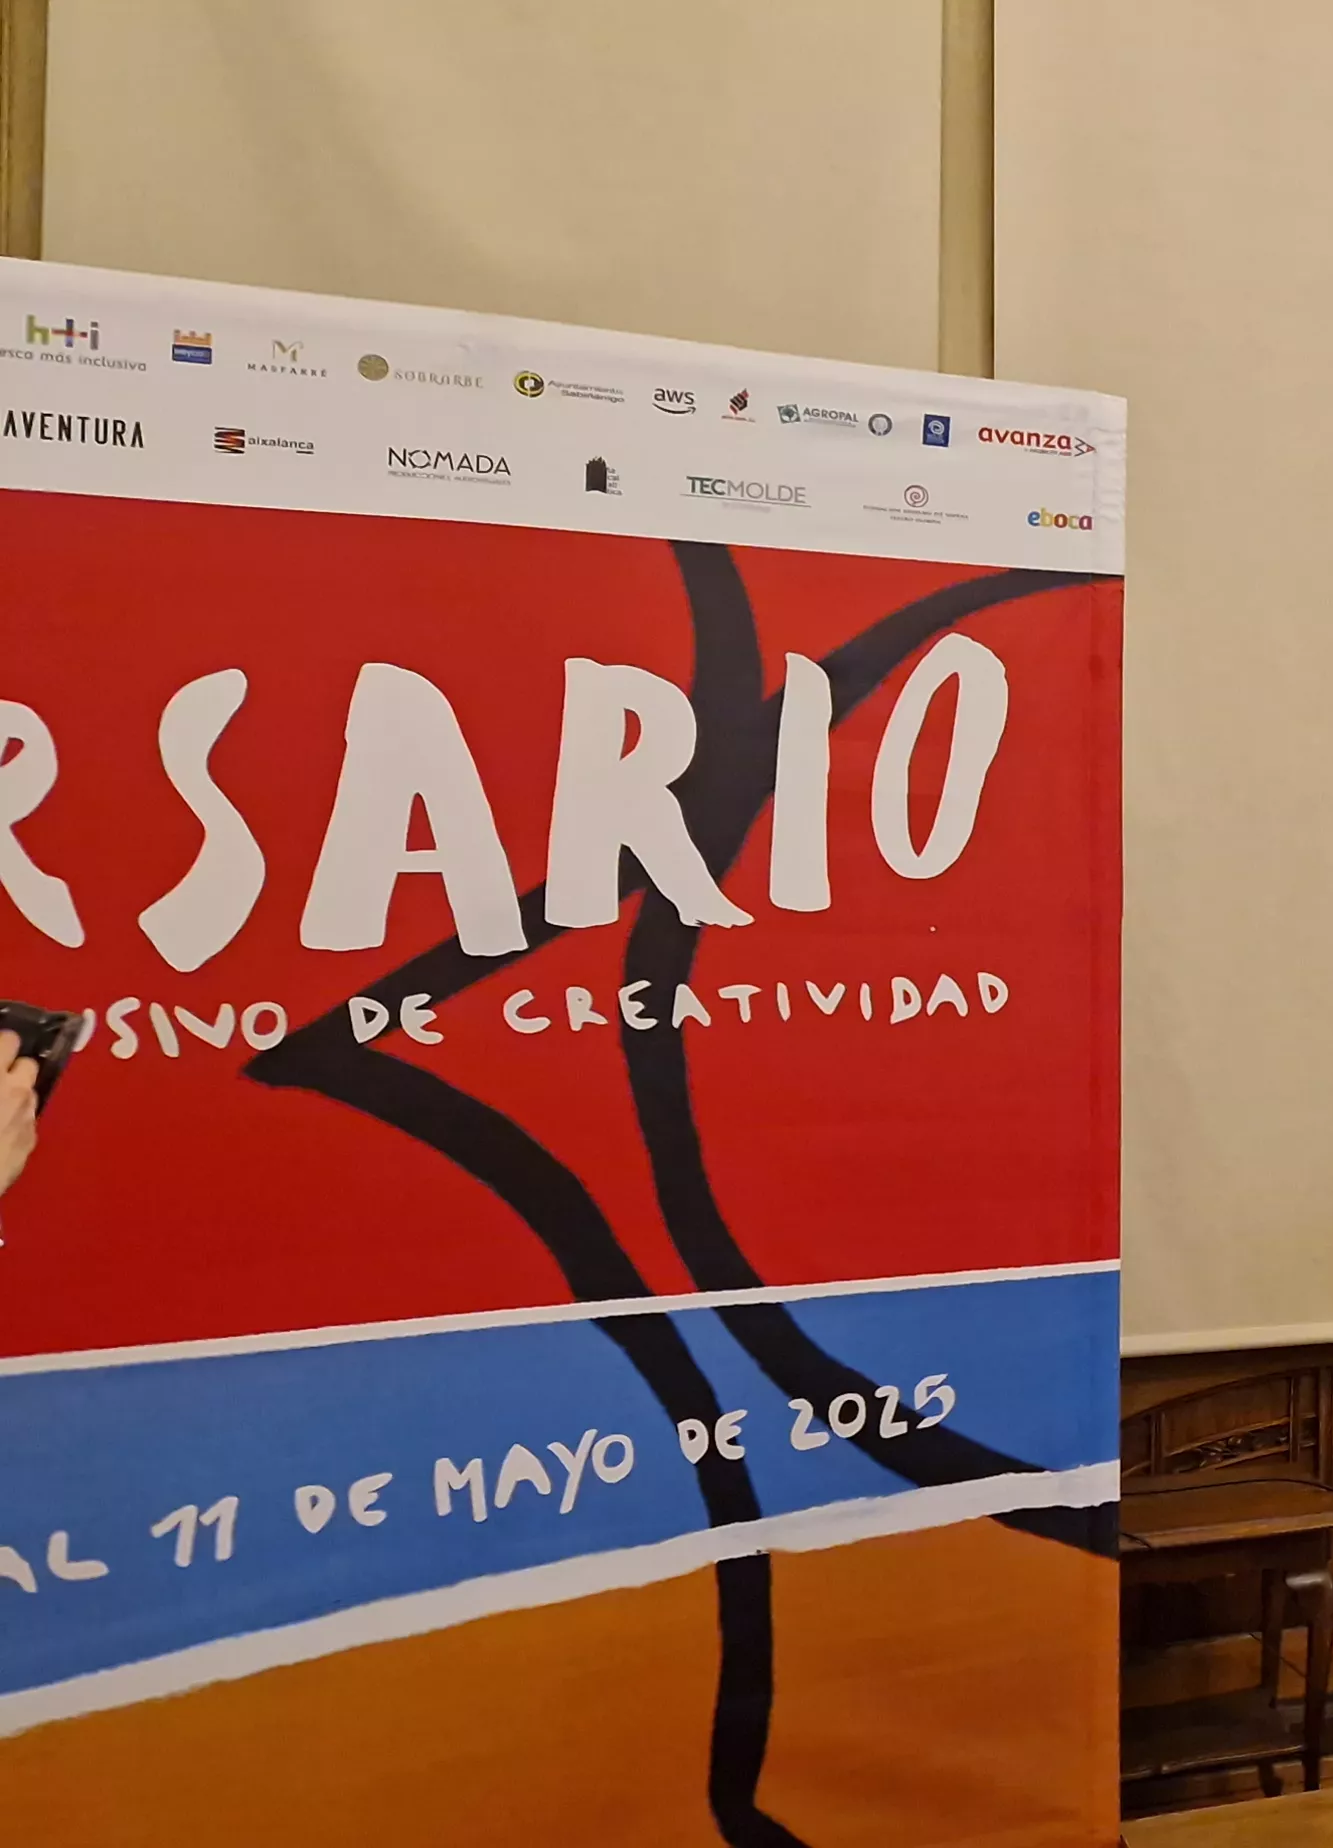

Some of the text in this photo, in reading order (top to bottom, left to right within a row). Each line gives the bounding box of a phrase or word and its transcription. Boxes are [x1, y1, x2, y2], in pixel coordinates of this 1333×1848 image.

[40, 351, 72, 363] más
[79, 356, 147, 371] inclusiva
[653, 387, 695, 405] aws
[803, 407, 859, 423] AGROPAL
[3, 410, 144, 448] AVENTURA
[978, 427, 1072, 450] avanza
[388, 447, 511, 476] NOMADA
[686, 476, 807, 503] TECMOLDE
[1027, 508, 1092, 530] eboca
[348, 992, 444, 1044] DE
[502, 972, 1008, 1034] CREATIVIDAD
[150, 1496, 239, 1567] 11
[294, 1471, 393, 1534] DE
[434, 1427, 634, 1523] MAYO
[676, 1408, 749, 1466] DE
[789, 1372, 956, 1451] 2025
